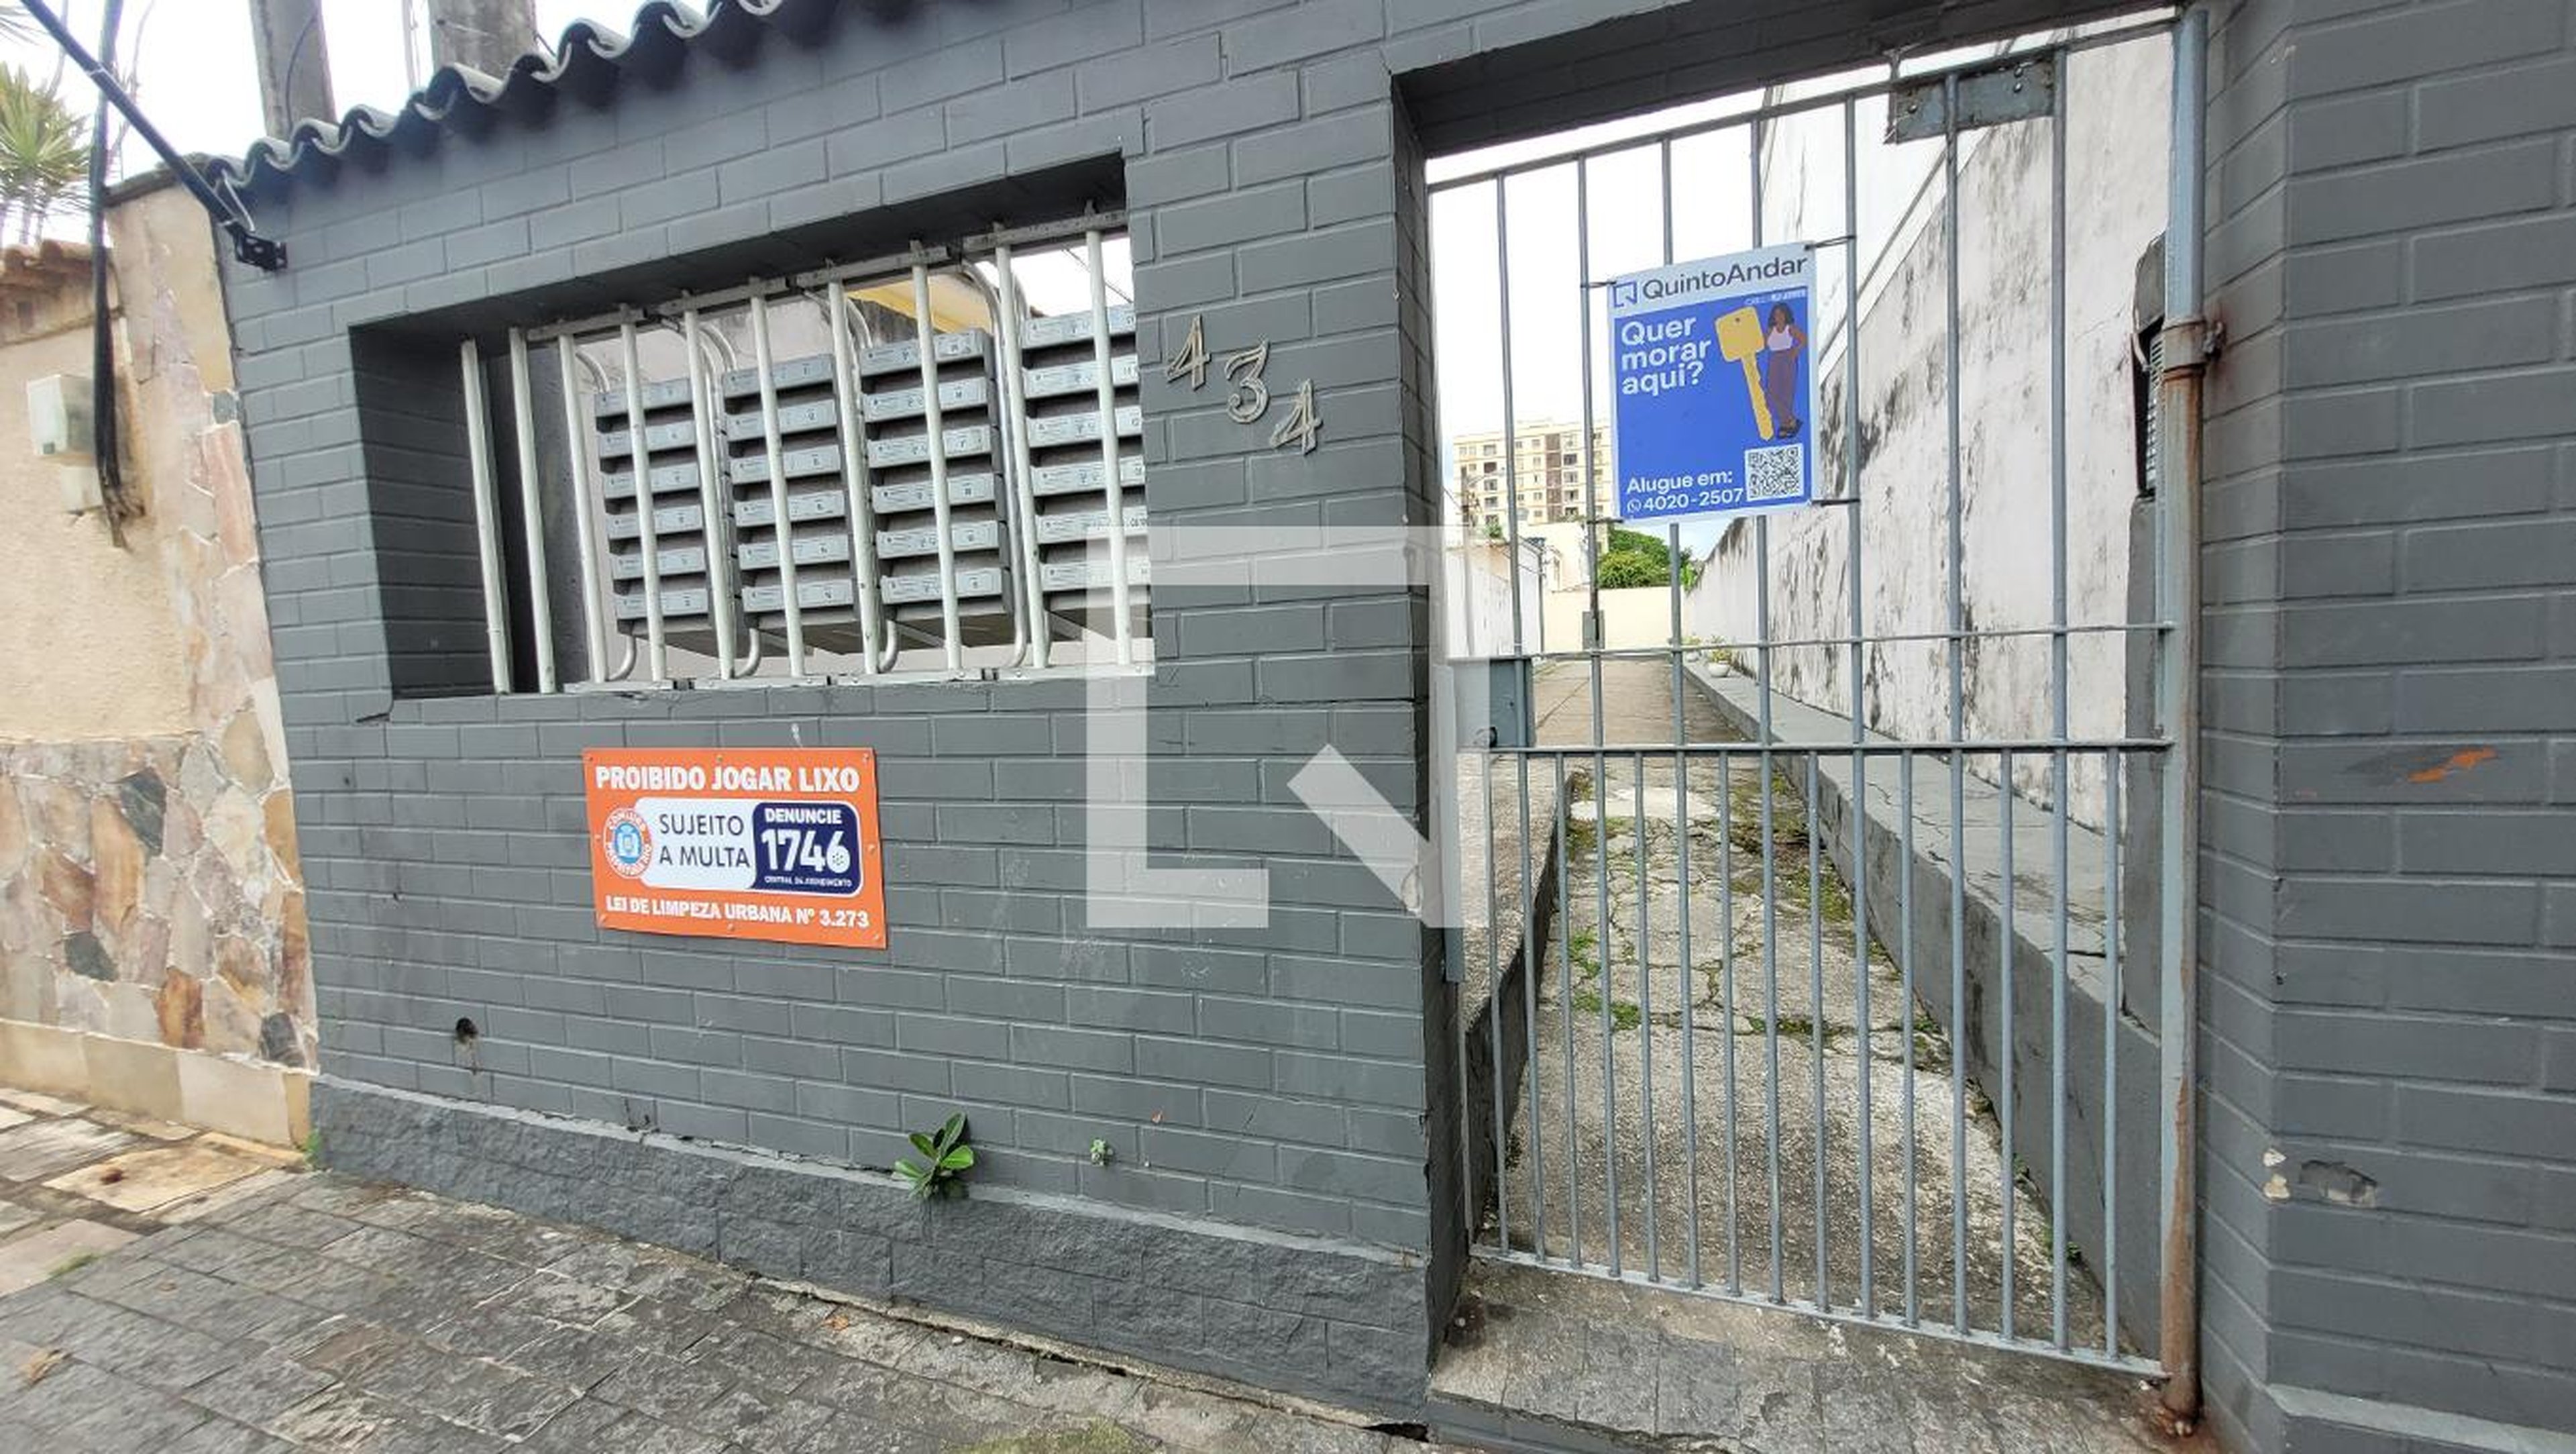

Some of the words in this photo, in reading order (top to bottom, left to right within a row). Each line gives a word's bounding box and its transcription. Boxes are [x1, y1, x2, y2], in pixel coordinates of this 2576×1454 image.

[1642, 256, 1809, 301] QuintoAndar
[1621, 317, 1697, 346] Quer
[1621, 340, 1712, 372] morar
[1166, 313, 1322, 456] 434
[1621, 360, 1705, 397] aqui?
[1626, 475, 1693, 497] Alugue
[1698, 470, 1733, 486] em:
[1642, 488, 1744, 513] 4020-2507
[596, 765, 706, 792] PROIBIDO
[711, 767, 793, 792] JOGAR
[798, 767, 860, 792] LIXO
[659, 813, 745, 837] SUJEITO
[764, 808, 843, 825] DENUNCIE
[659, 845, 673, 865] A
[679, 846, 751, 868] MULTA
[761, 829, 851, 874] 1746
[606, 895, 628, 912] LEI
[631, 898, 649, 914] DE
[653, 898, 721, 919] LIMPEZA
[724, 903, 792, 923] URBANA
[819, 911, 869, 928] 3.273
